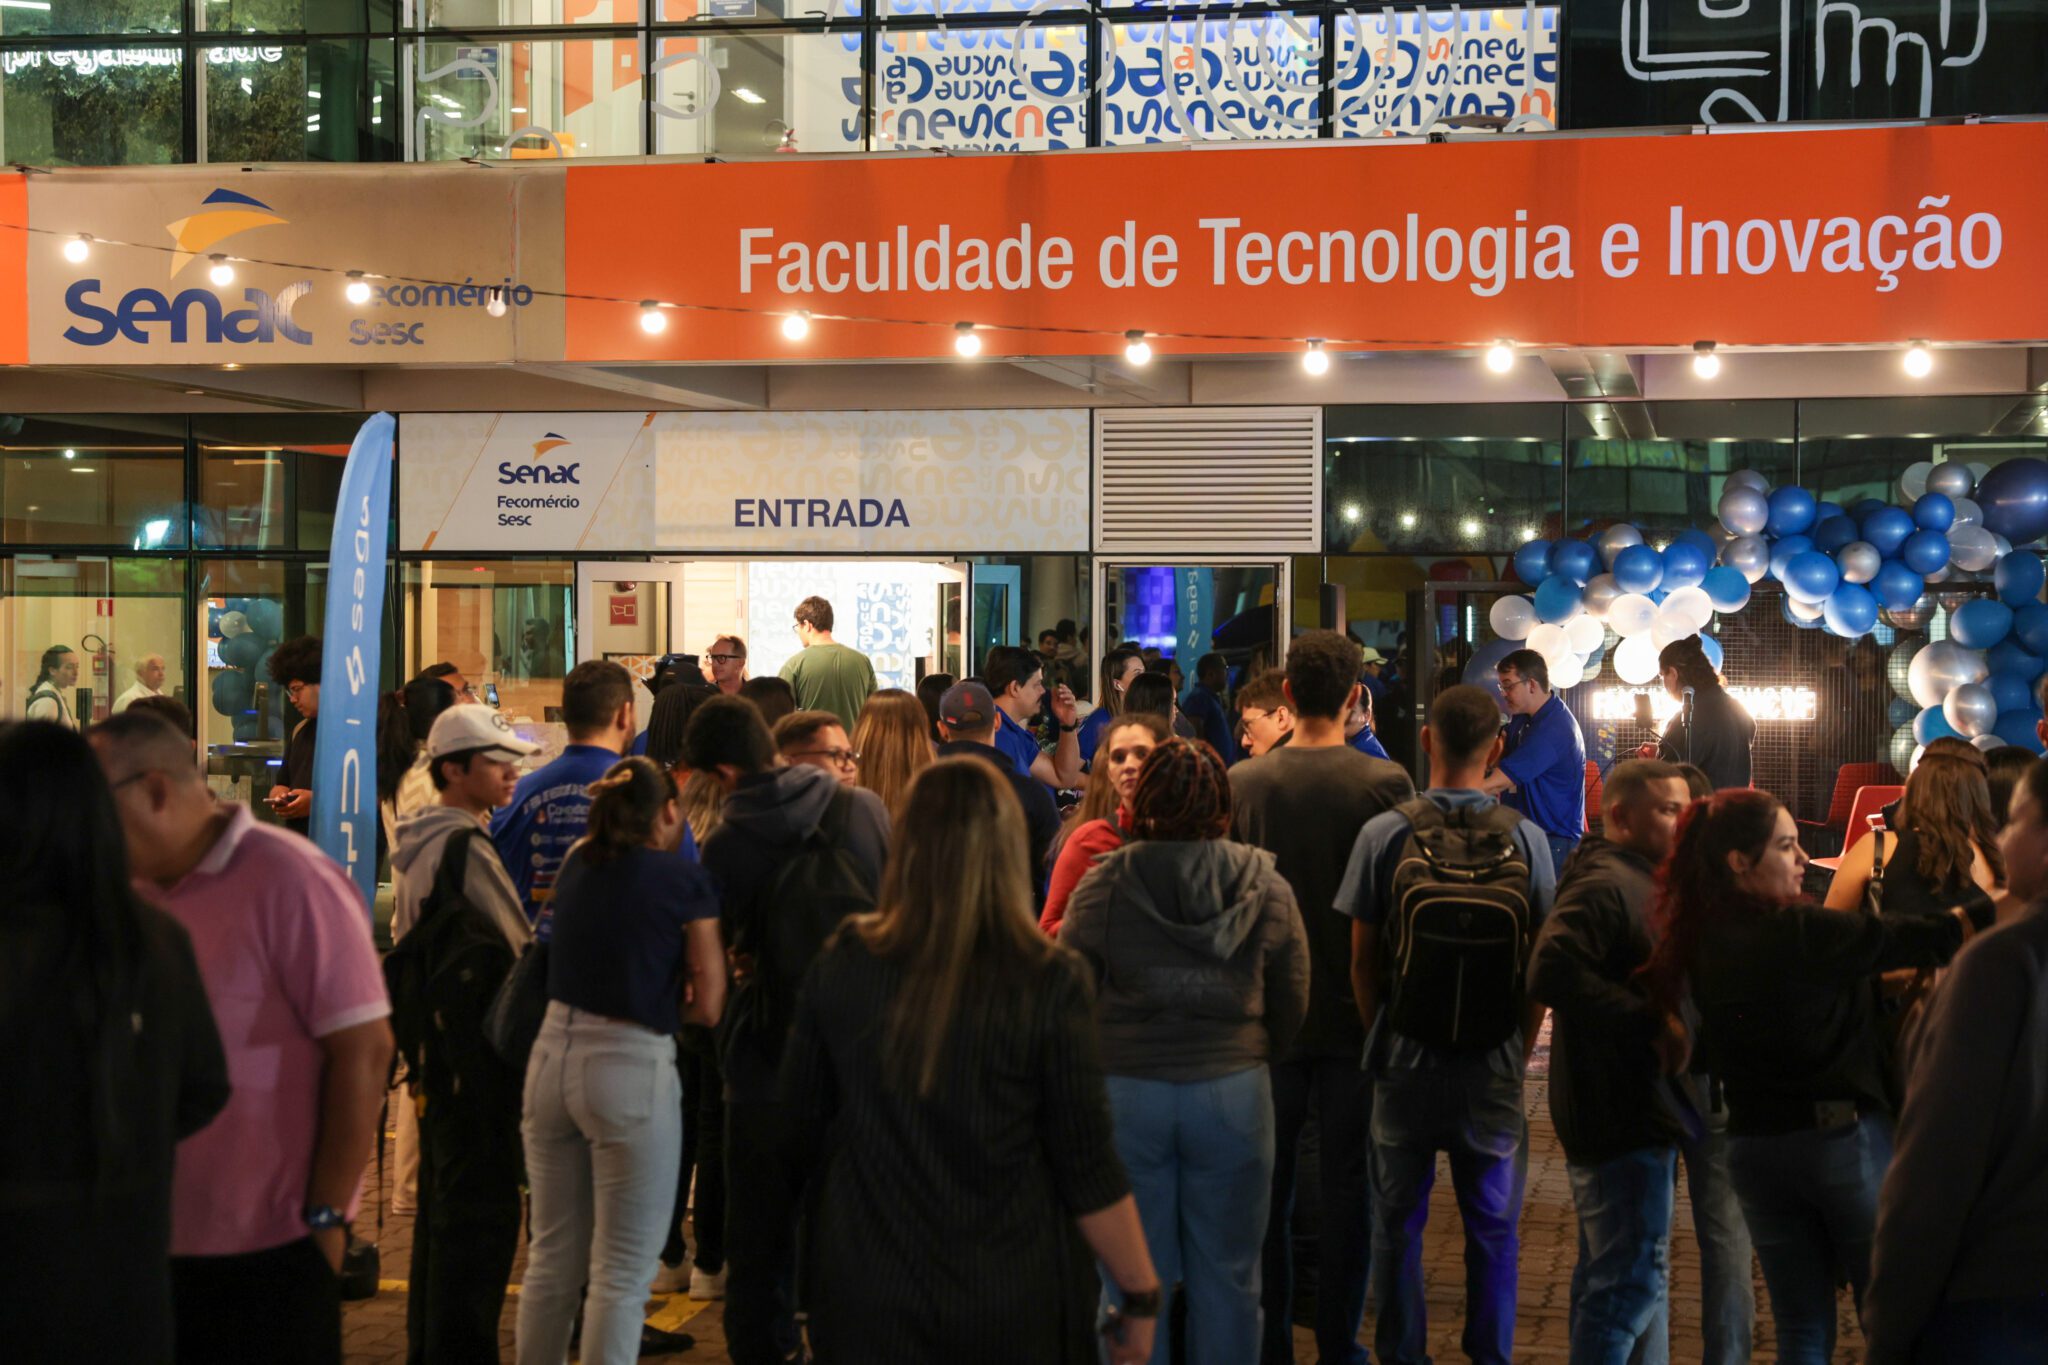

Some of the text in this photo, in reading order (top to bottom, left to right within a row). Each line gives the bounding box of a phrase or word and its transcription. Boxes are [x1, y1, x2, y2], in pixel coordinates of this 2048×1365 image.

[738, 194, 2003, 297] Faculdade de Tecnologia e Inovação
[62, 278, 313, 347] Senac
[348, 319, 425, 346] Sesc
[498, 461, 580, 485] Senac
[497, 494, 580, 509] Fecomércio
[734, 498, 911, 528] ENTRADA
[498, 513, 533, 527] Sesc
